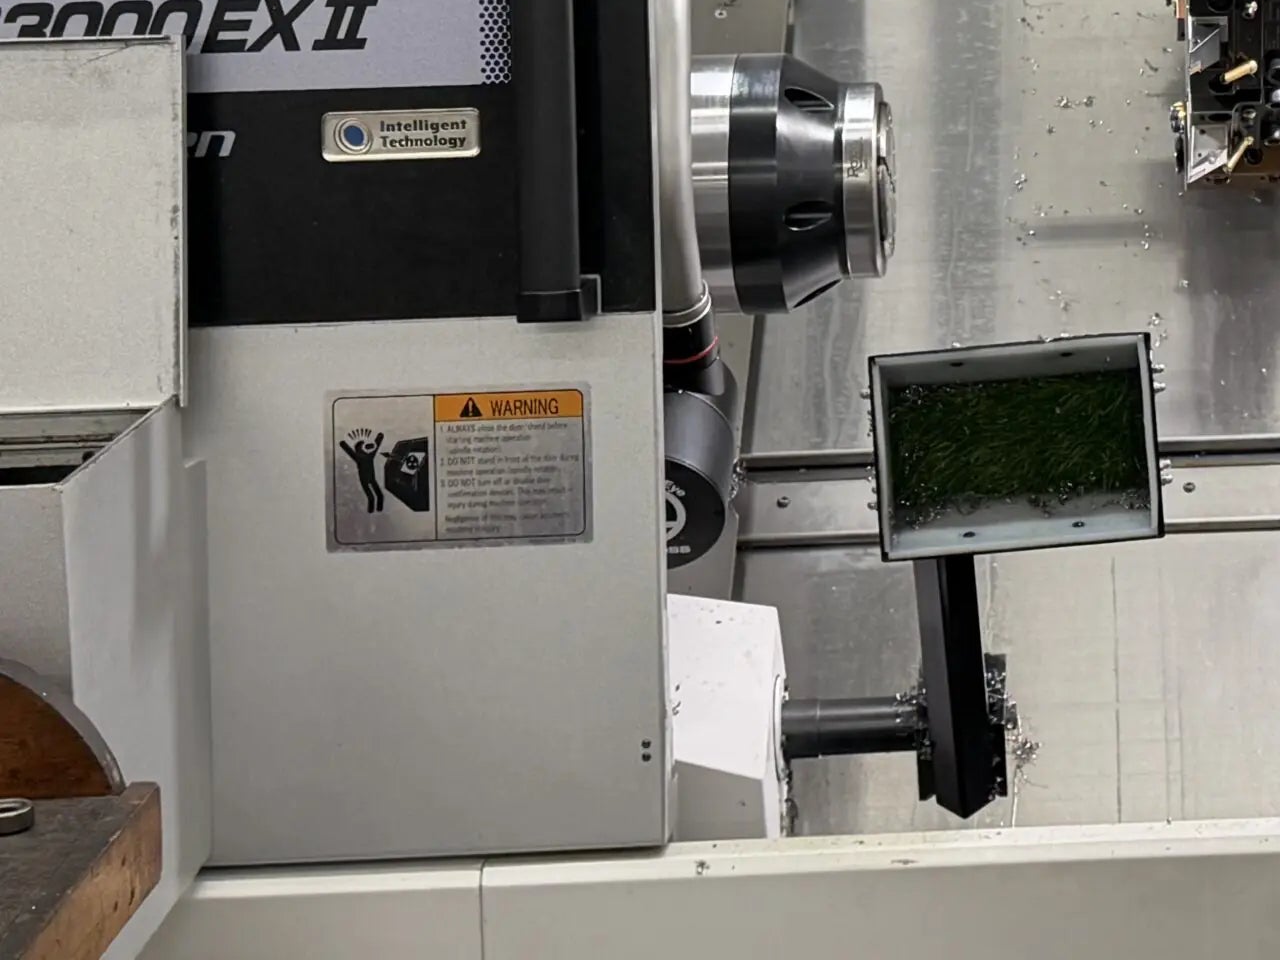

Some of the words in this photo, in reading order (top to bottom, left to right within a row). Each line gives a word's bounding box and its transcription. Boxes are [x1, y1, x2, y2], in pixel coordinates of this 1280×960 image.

[380, 120, 467, 133] Intelligent
[380, 135, 466, 148] Technology
[490, 398, 559, 417] WARNING
